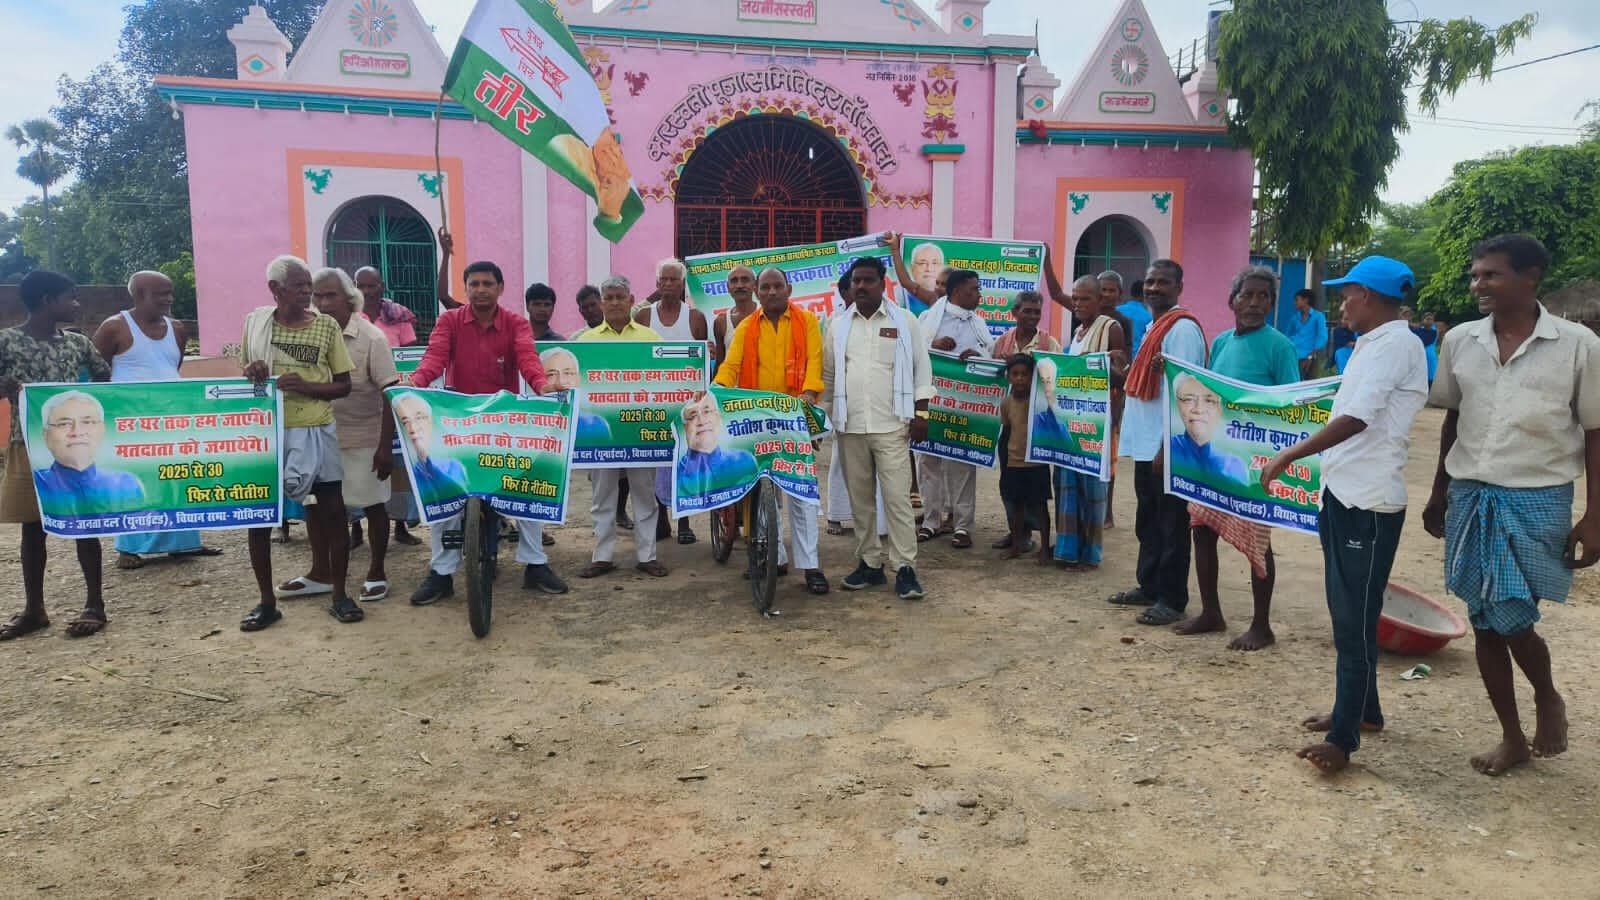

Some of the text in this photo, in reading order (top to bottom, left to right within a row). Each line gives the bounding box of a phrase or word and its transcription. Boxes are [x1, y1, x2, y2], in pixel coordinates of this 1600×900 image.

[775, 0, 815, 19] सरस्वती
[474, 71, 545, 134] तीर
[587, 369, 601, 382] हर
[604, 369, 619, 381] घर
[622, 369, 641, 381] तक
[644, 369, 661, 381] हम
[587, 391, 629, 403] मतदाता
[632, 388, 650, 403] को
[722, 398, 754, 413] जनता
[115, 417, 134, 432] हर
[138, 415, 161, 431] घर
[164, 414, 190, 429] तक
[195, 412, 216, 428] हम
[508, 412, 528, 425] हम
[619, 407, 666, 422] 2025 से 30
[639, 428, 656, 441] फिर
[658, 428, 668, 441] से
[726, 419, 763, 436] नीतीश
[765, 418, 795, 436] कुमार
[1226, 420, 1265, 444] नीतीश
[493, 431, 512, 448] को
[754, 439, 812, 454] 2025 से 30
[114, 442, 175, 459] मतदाता
[178, 438, 201, 455] को
[478, 453, 531, 470] 2025 से 30
[771, 458, 792, 473] फिर
[793, 459, 805, 474] से
[159, 461, 224, 480] 2025 से 30
[1297, 464, 1311, 481] 30
[187, 482, 269, 503] फिर से नीतीश
[502, 475, 556, 497] फिर से नीतीश
[1296, 486, 1308, 504] से
[76, 516, 101, 528] जनता
[104, 516, 119, 527] दल
[176, 510, 205, 523] विधान
[232, 507, 275, 522] गोविन्दपुर
[1273, 506, 1298, 523] विधान
